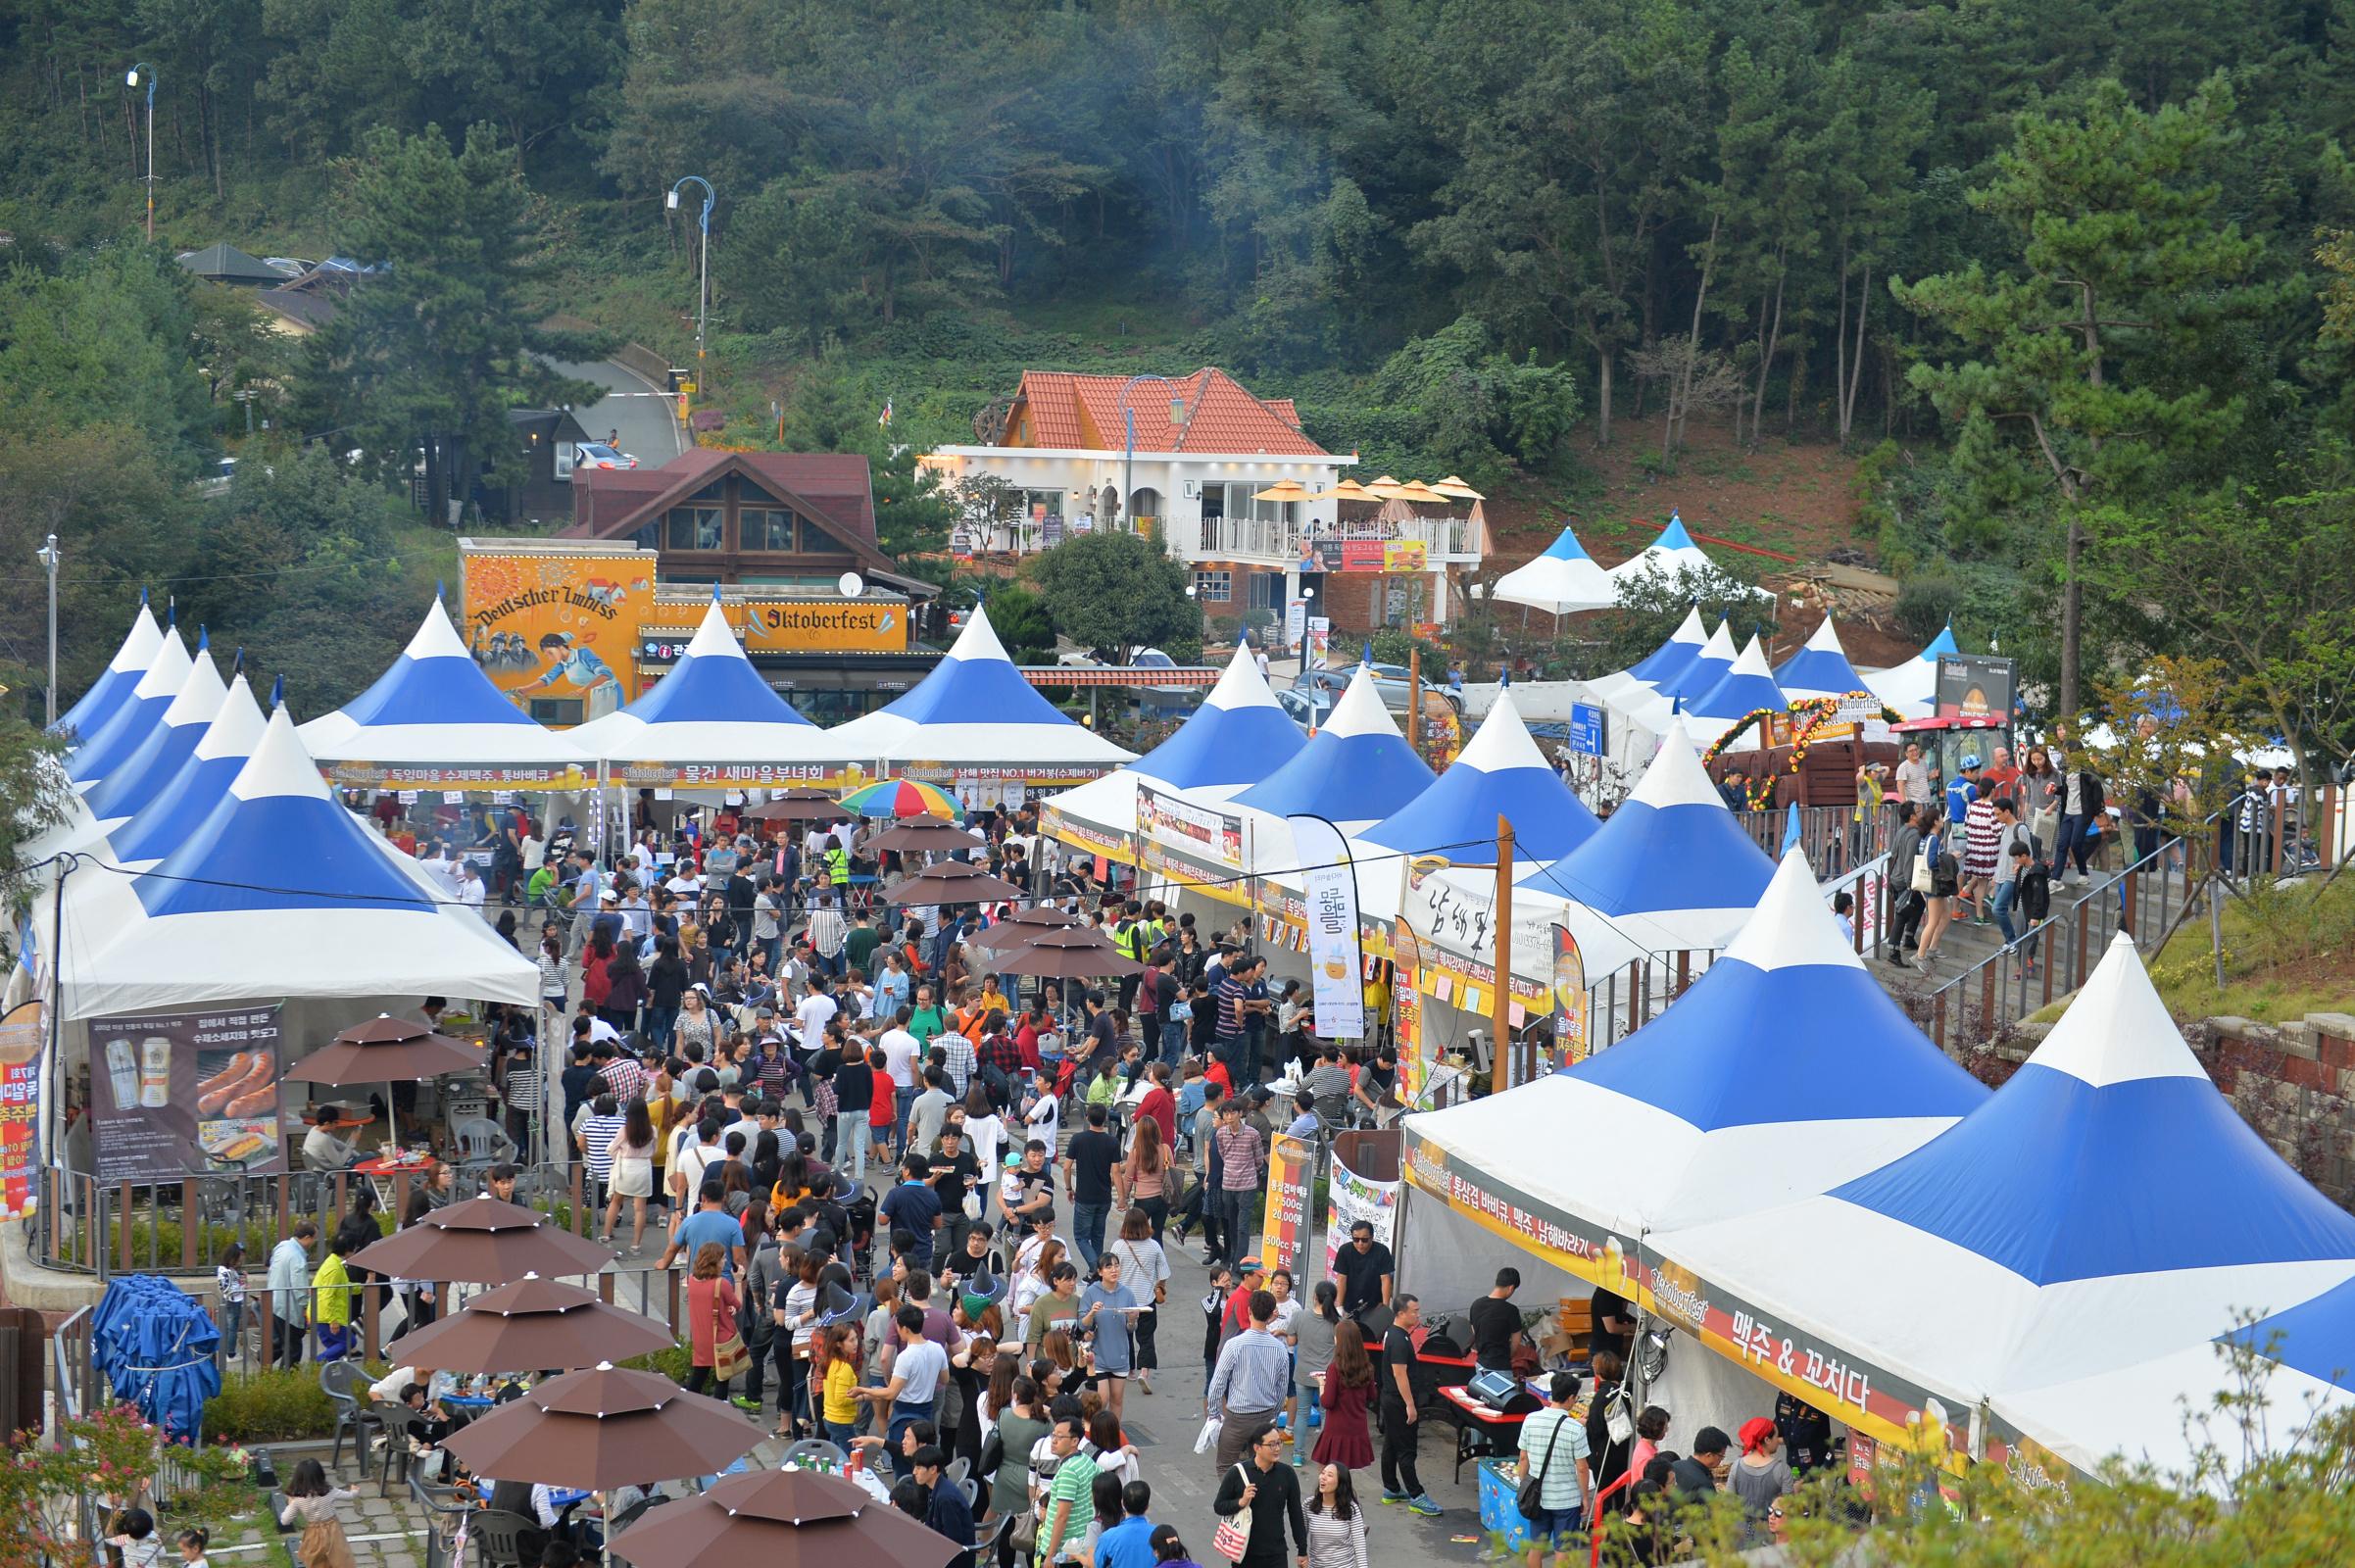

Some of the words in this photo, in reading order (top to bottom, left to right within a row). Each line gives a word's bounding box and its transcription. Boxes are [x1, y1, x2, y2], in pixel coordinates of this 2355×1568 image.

[474, 588, 560, 627] Deutscher
[767, 608, 878, 630] Oktoberfest
[391, 769, 441, 782] 독일마을
[445, 769, 497, 783] 수제맥주,
[502, 769, 549, 782] 통바베큐
[685, 765, 717, 784] 물건
[724, 765, 824, 783] 새마을부녀회
[958, 768, 977, 779] 남해
[980, 768, 1000, 779] 맛집
[1003, 768, 1024, 778] NO.1
[1027, 767, 1100, 779] 버거봉(수제버거)
[1429, 885, 1496, 951] 남해포
[1282, 1197, 1303, 1211] 500cc
[1272, 1208, 1303, 1226] 20,000원
[1453, 1176, 1479, 1210] 통삼겹
[1481, 1191, 1512, 1228] 바비큐,
[1514, 1207, 1536, 1240] 맥주,
[1539, 1219, 1590, 1259] 남해바라기
[1265, 1236, 1290, 1250] 500cc
[1278, 1253, 1292, 1267] 또는
[1650, 1267, 1708, 1323] Oktoberfest
[1733, 1310, 1773, 1365] 맥주
[1778, 1338, 1794, 1377] &
[1801, 1348, 1871, 1414] 꼬치다
